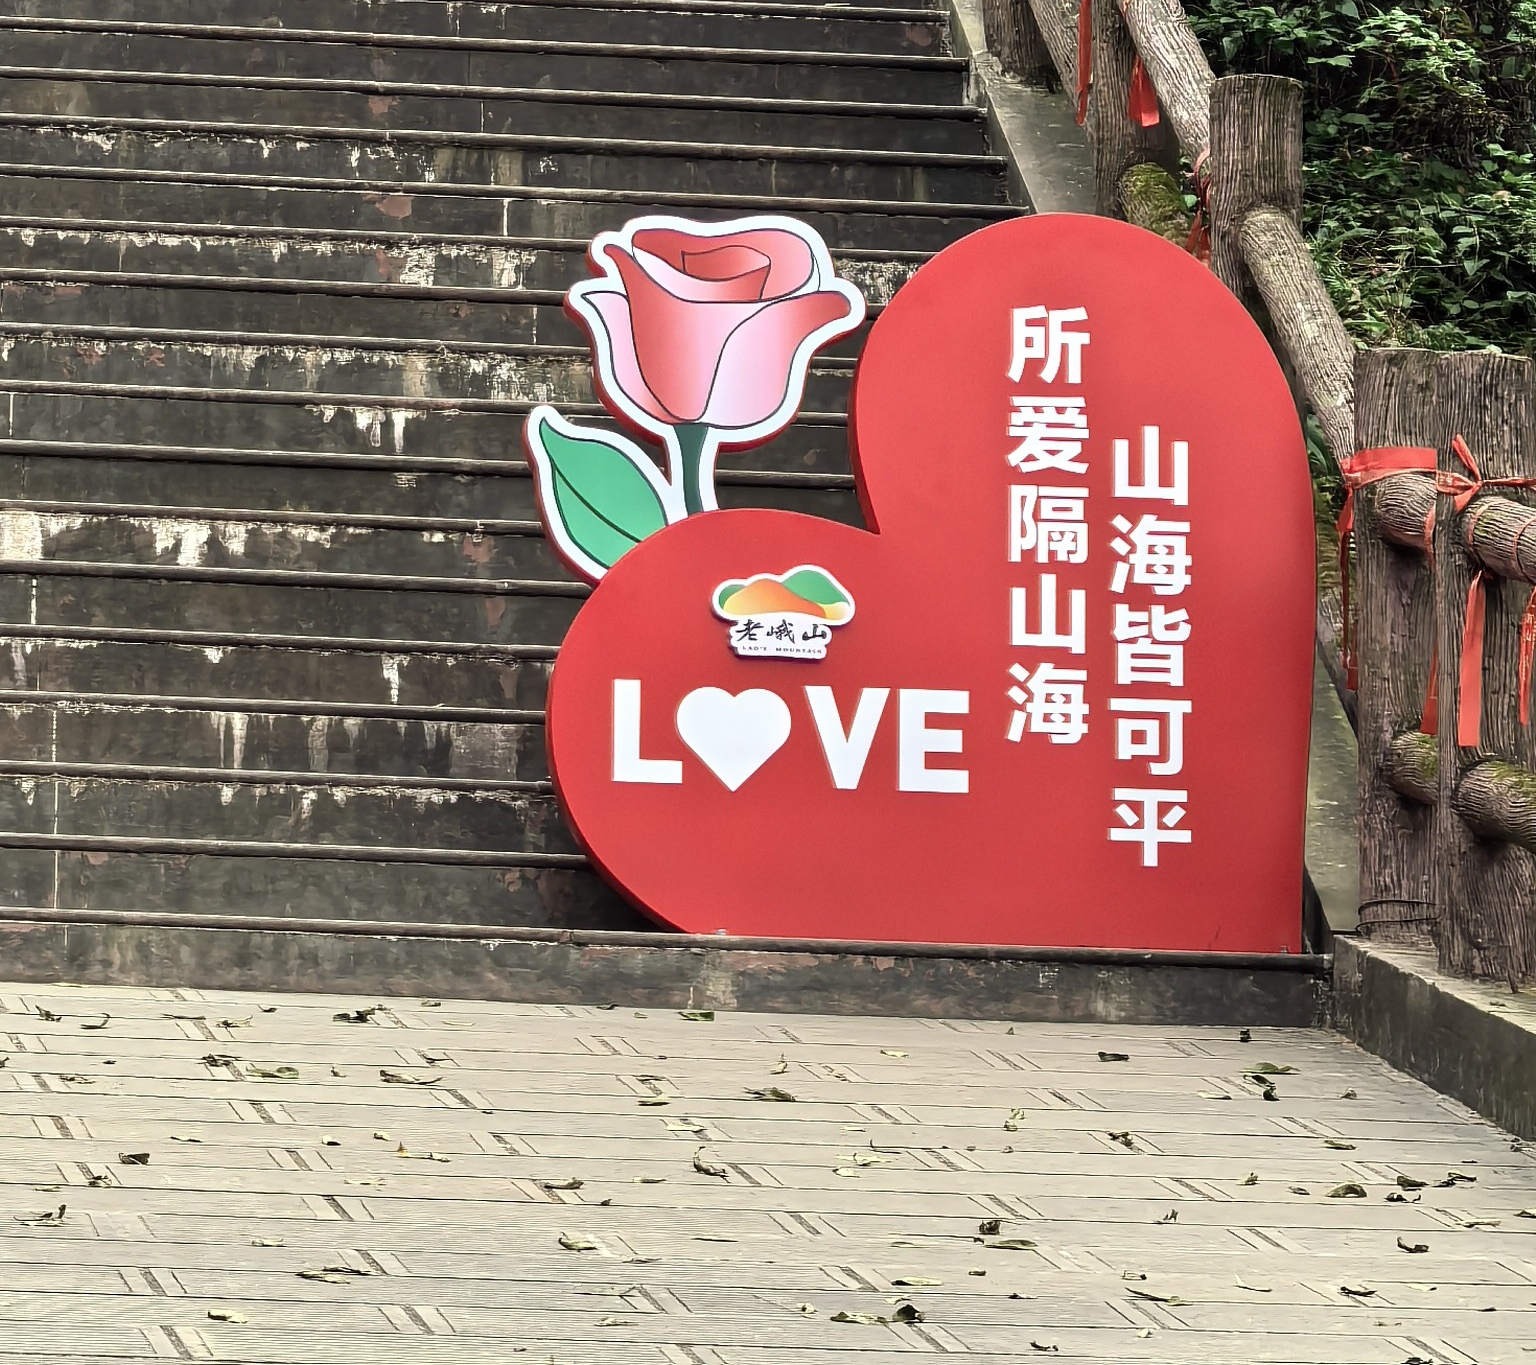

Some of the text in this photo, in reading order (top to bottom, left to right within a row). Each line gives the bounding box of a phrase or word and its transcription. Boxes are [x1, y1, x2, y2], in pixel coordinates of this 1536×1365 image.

[735, 618, 827, 644] 老峨山
[1007, 305, 1091, 744] 所爱隔山海
[1109, 425, 1193, 867] 山海皆可平
